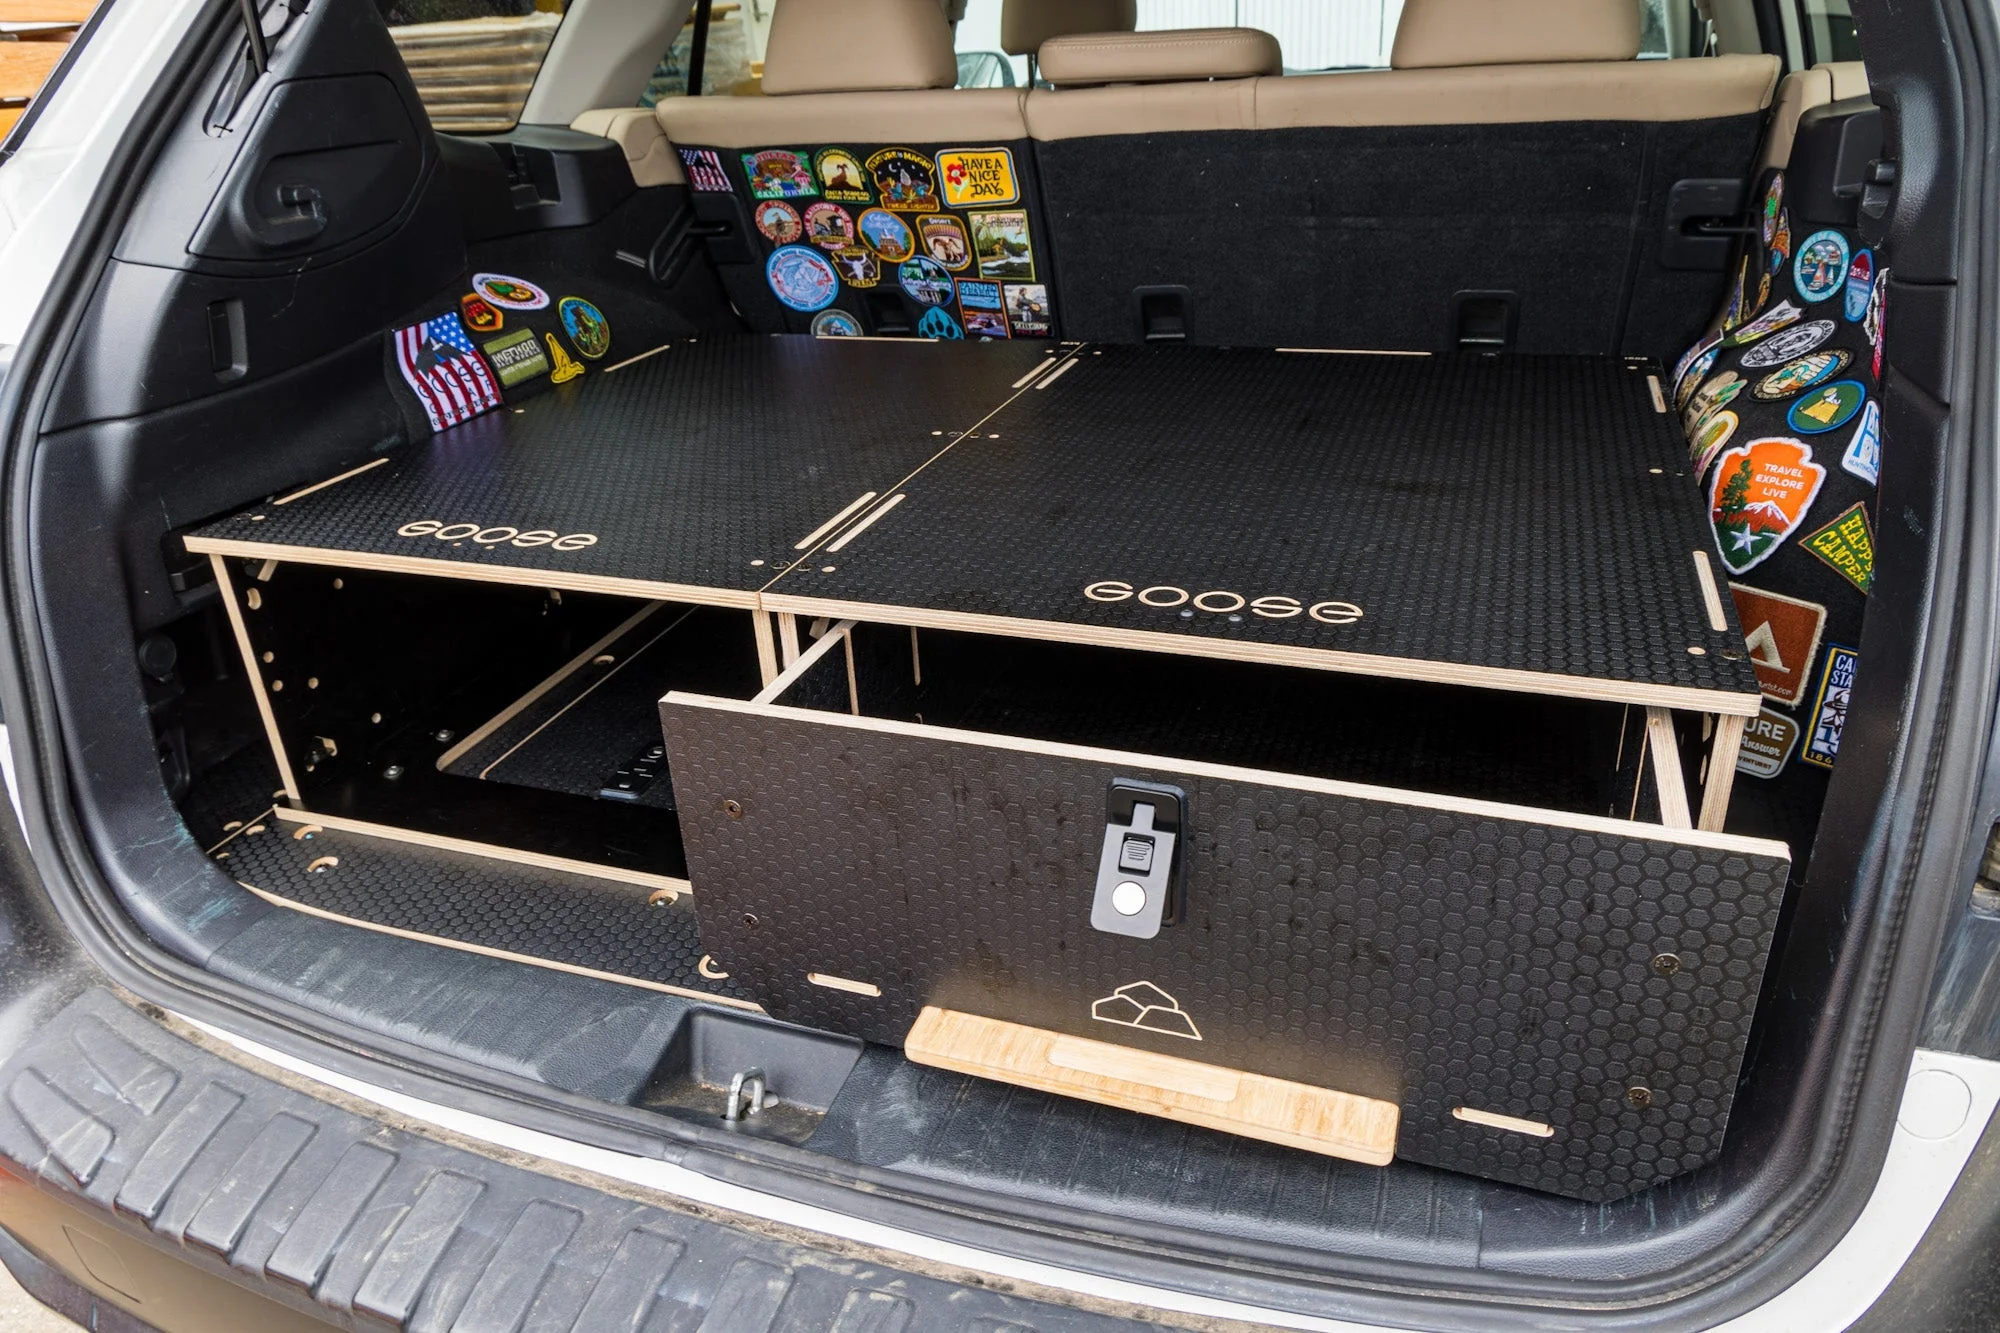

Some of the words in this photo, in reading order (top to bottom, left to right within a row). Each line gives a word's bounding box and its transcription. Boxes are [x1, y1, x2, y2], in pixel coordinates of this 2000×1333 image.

[868, 151, 897, 170] NATURE
[903, 152, 932, 170] MAGIC
[958, 156, 993, 170] HAVE
[994, 158, 1004, 170] A
[968, 169, 1001, 183] NICE
[756, 187, 817, 198] CALIFORNIA
[970, 182, 1004, 198] DAY
[491, 339, 536, 364] METHOD
[1764, 463, 1804, 478] TRAVEL
[1755, 473, 1805, 490] EXPLORE
[1762, 487, 1788, 499] LIVE
[397, 520, 599, 551] GOOSE
[1812, 530, 1866, 583] CAMPER
[1083, 580, 1365, 625] GOOSE
[1744, 716, 1787, 741] URE
[1810, 750, 1832, 764] 186
